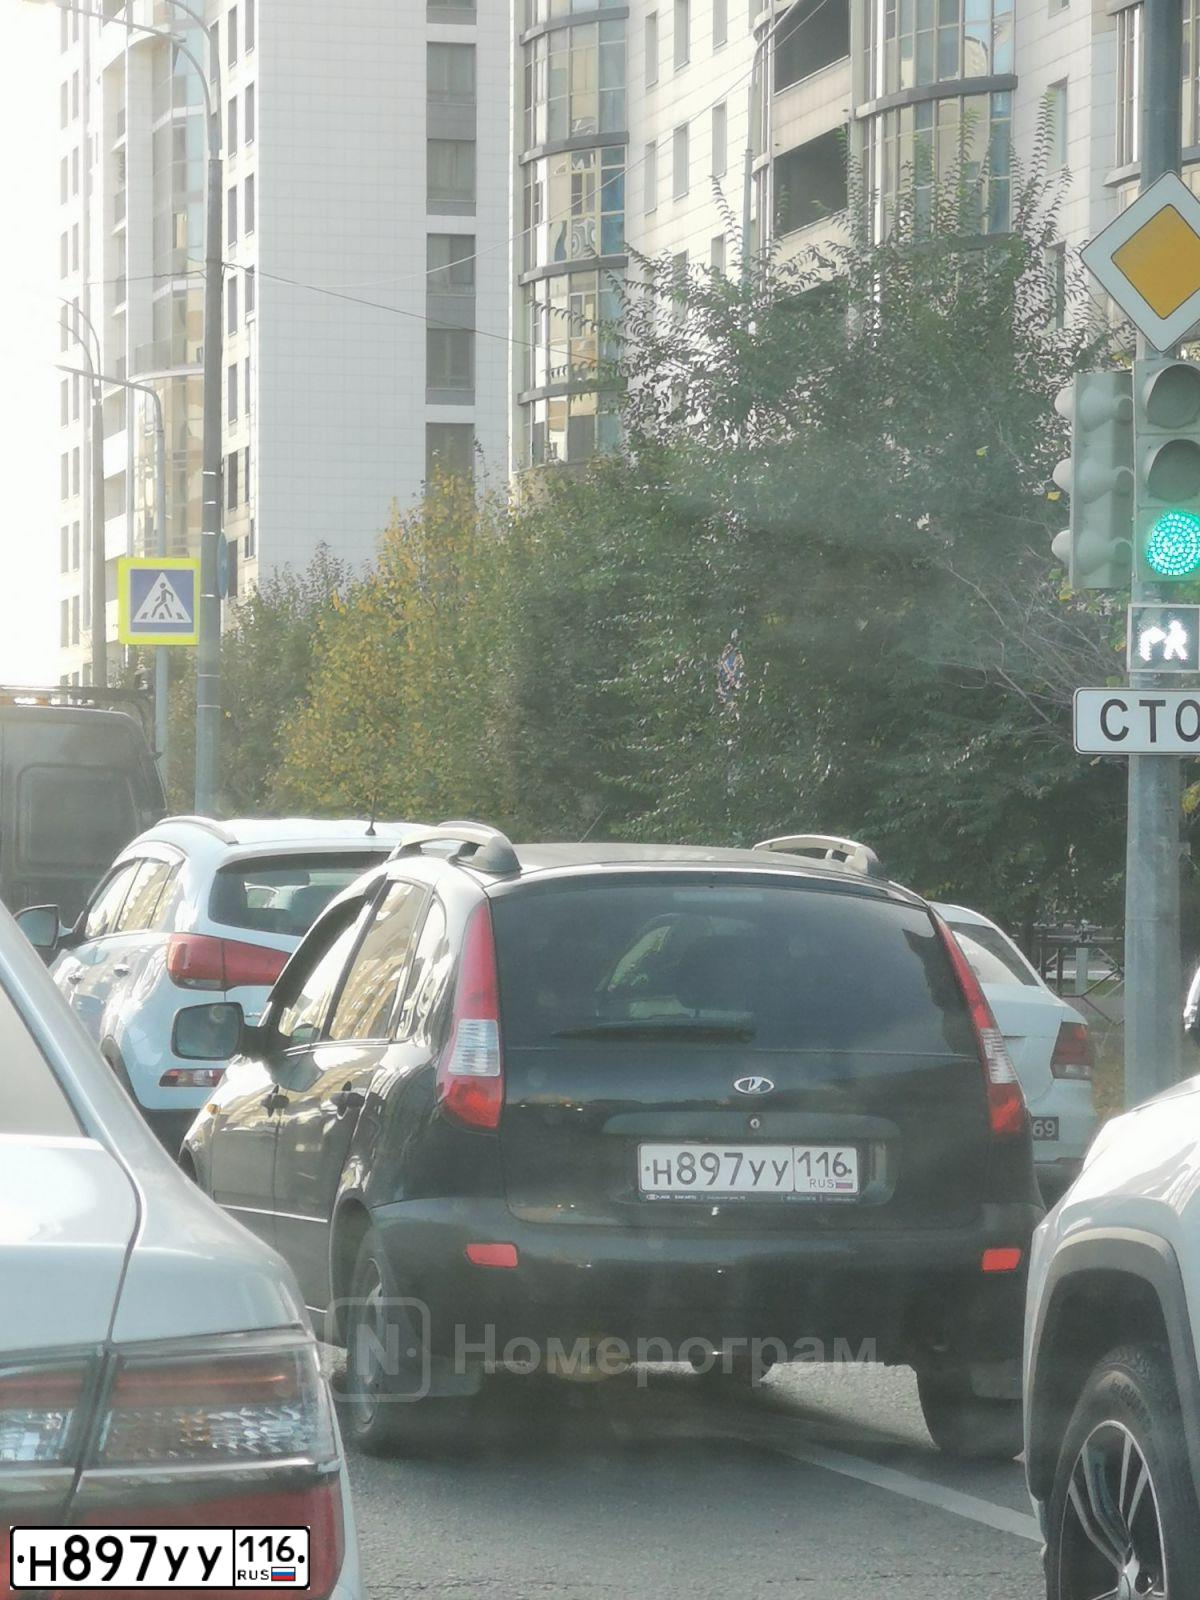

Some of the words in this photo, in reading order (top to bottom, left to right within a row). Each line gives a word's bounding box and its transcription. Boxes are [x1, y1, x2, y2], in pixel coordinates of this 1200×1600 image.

[1032, 1119, 1056, 1137] 69
[797, 1151, 849, 1177] 116
[809, 1178, 835, 1188] RUS
